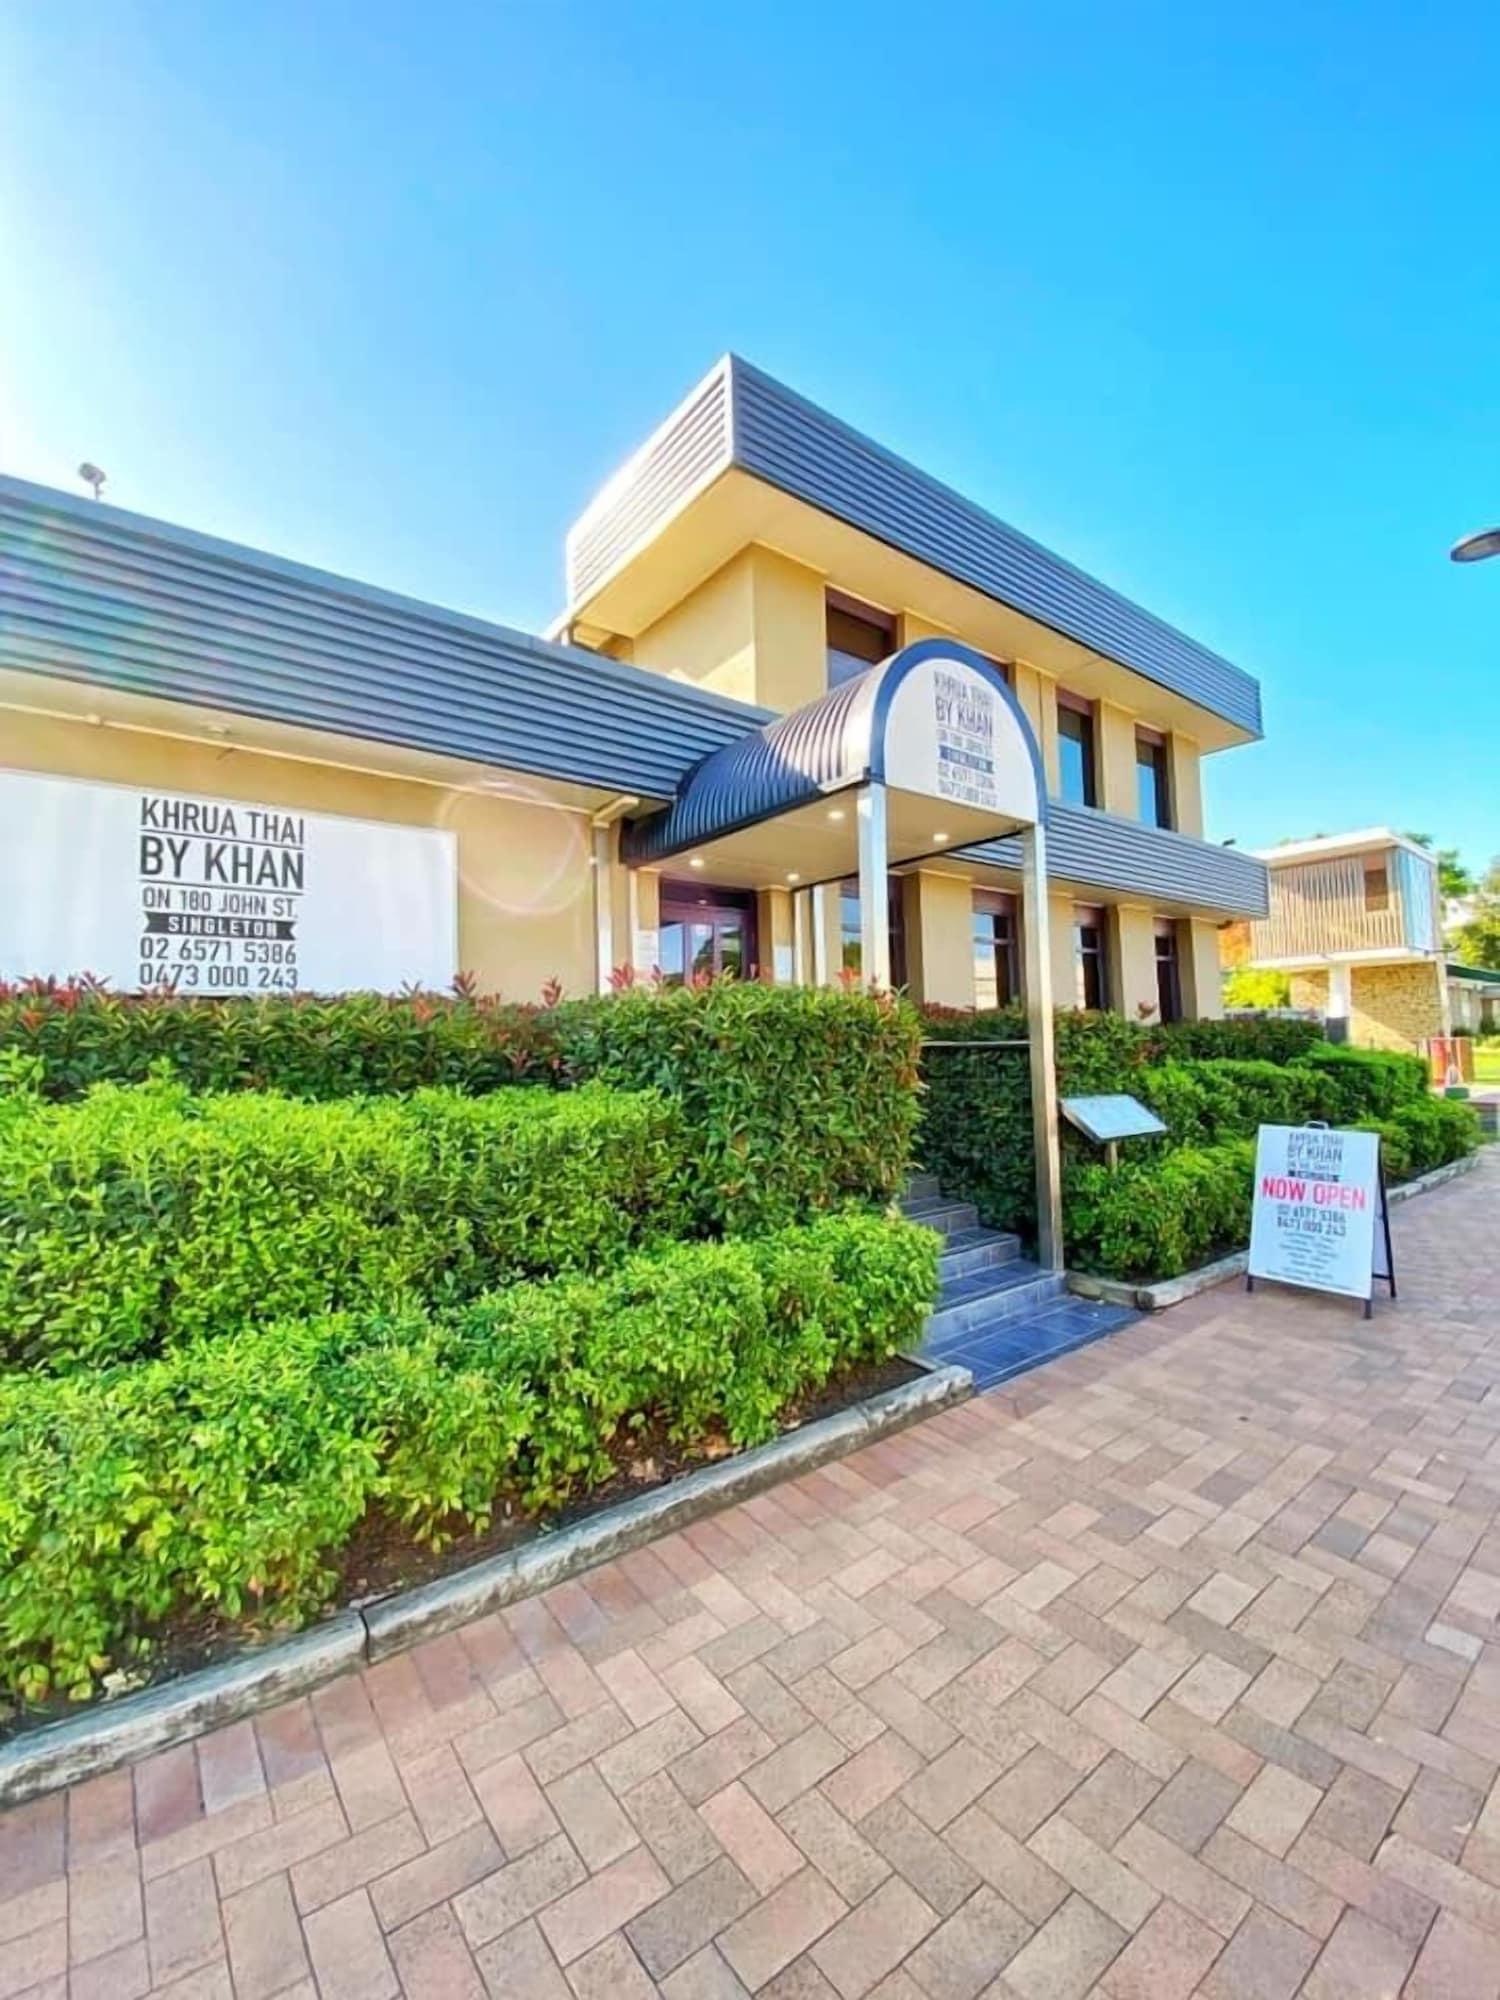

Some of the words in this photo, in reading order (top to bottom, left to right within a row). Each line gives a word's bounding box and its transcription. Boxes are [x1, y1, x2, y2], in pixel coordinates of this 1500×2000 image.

[935, 696, 953, 723] BY
[140, 797, 237, 835] KHRUA
[245, 811, 304, 844] THAI
[140, 835, 190, 878] BY
[204, 842, 304, 889] KHAN
[142, 887, 170, 909] ON
[180, 890, 212, 912] 180
[218, 893, 267, 916] JOHN
[168, 916, 278, 938] SINGLETON
[140, 936, 169, 960] 02
[179, 938, 232, 963] 6571
[243, 941, 297, 965] 5386
[139, 962, 199, 990] 0473
[207, 965, 249, 987] 000
[257, 966, 299, 989] 243
[1262, 1176, 1306, 1201] NOW
[1313, 1180, 1366, 1211] OPEN
